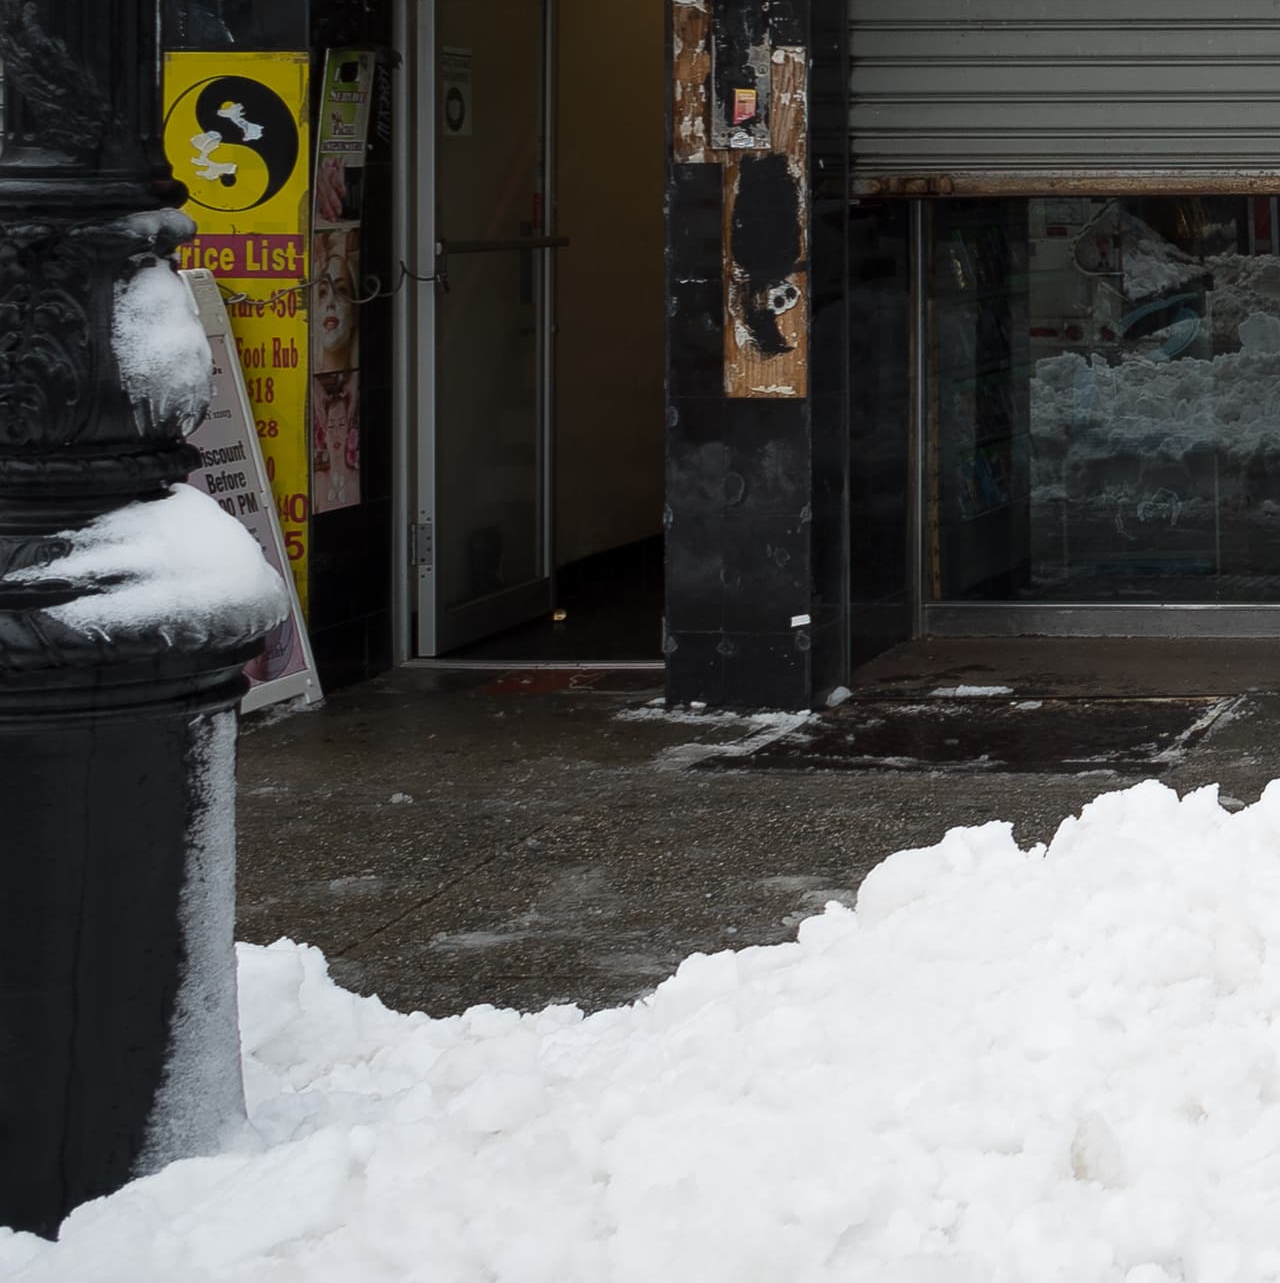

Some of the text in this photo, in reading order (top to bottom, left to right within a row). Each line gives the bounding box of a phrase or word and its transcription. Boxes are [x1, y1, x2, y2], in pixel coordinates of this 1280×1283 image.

[175, 238, 297, 271] rice List
[270, 288, 297, 319] $50
[236, 336, 266, 369] Foot
[271, 336, 299, 369] Rub
[247, 377, 274, 404] $18
[199, 440, 247, 468] iscount
[205, 471, 247, 495] Before
[236, 492, 260, 516] PM
